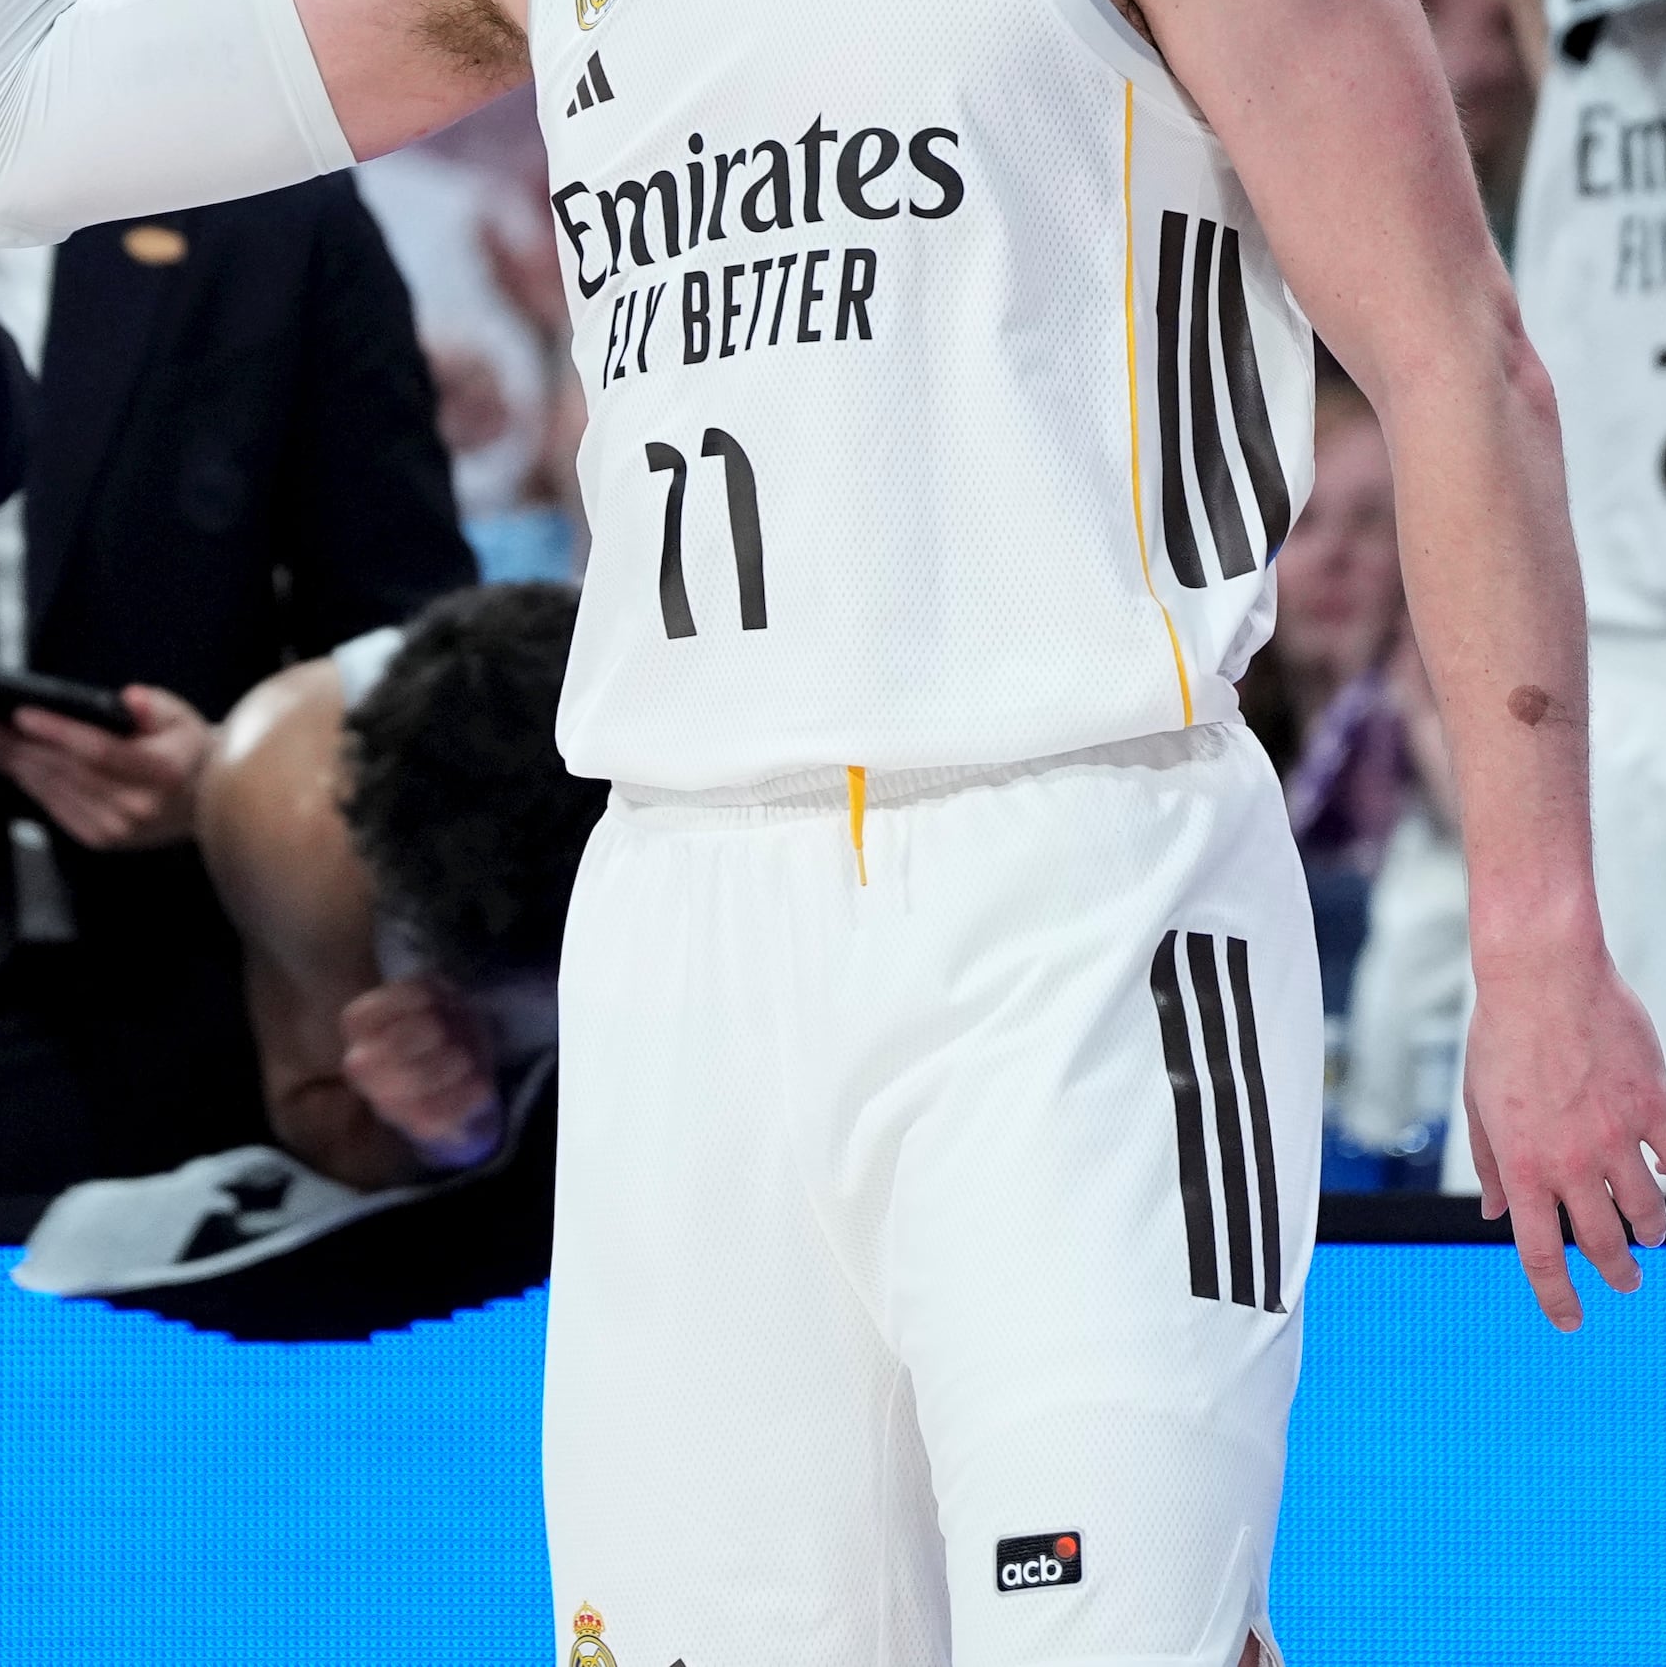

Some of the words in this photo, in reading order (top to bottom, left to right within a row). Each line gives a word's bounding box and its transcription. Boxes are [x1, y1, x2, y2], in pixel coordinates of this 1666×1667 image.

[551, 112, 965, 300] Emirates
[602, 281, 668, 390] FLY
[682, 247, 878, 366] BETTER
[644, 427, 768, 640] 11
[1001, 1554, 1063, 1586] acb
